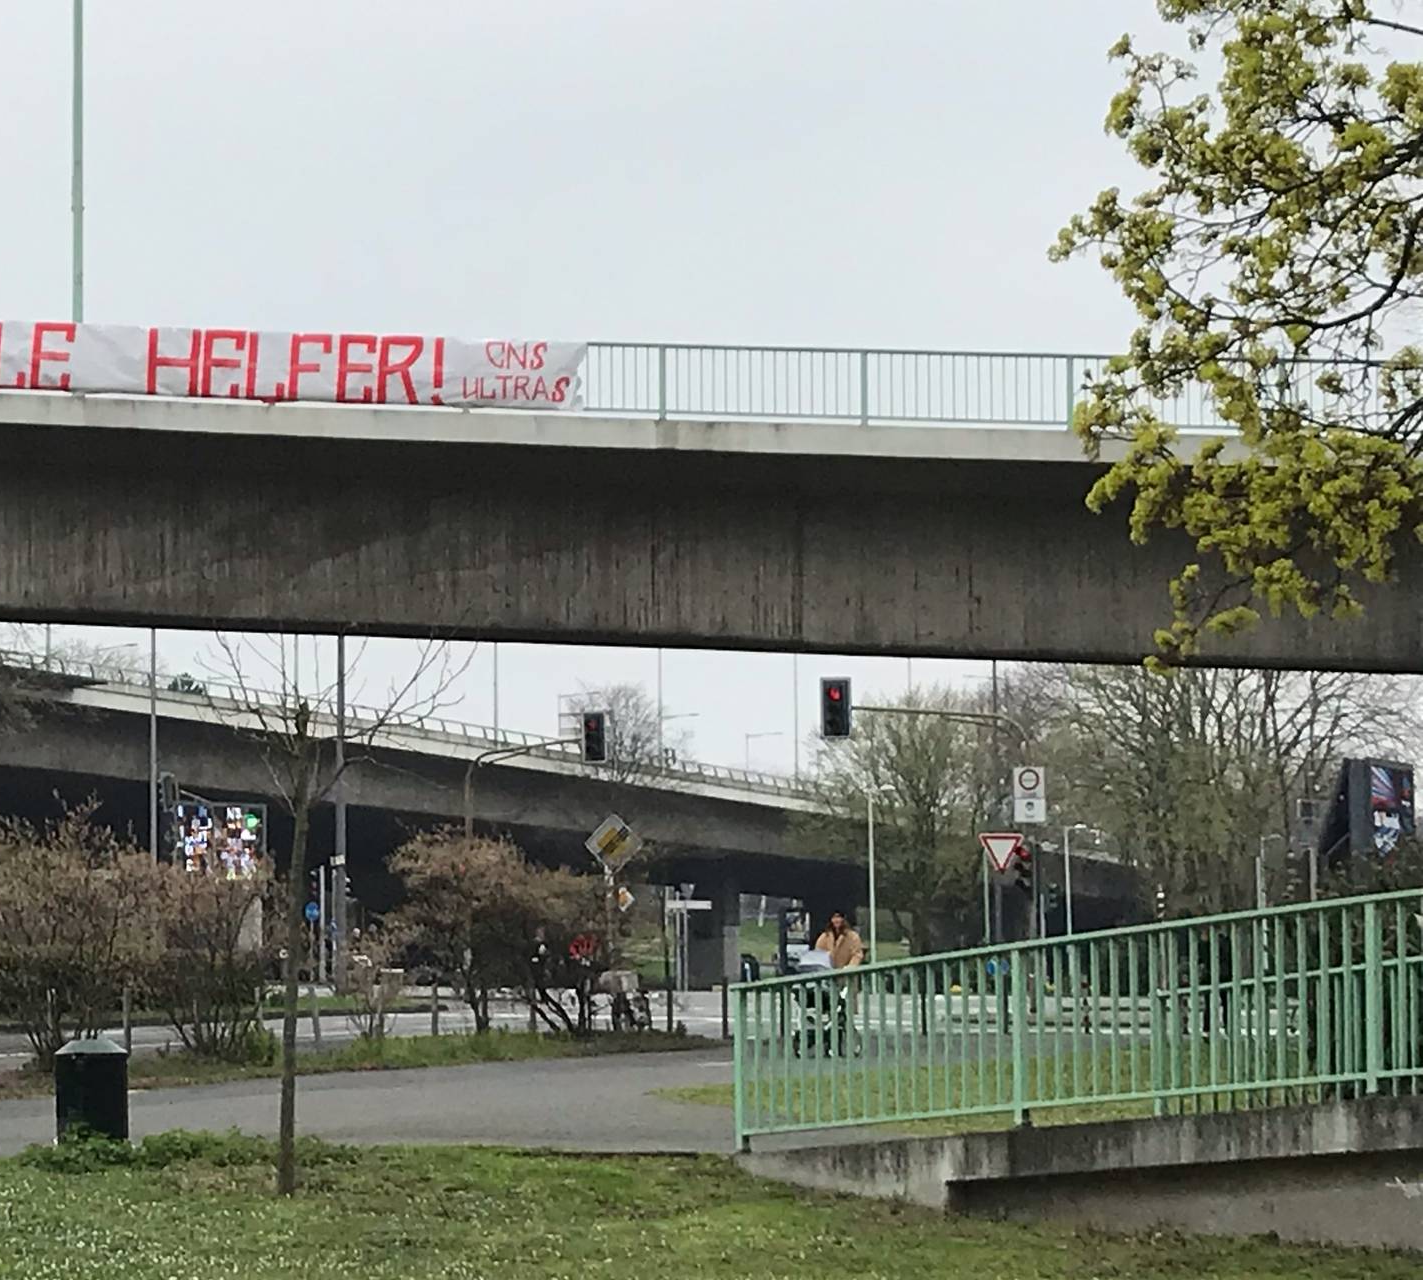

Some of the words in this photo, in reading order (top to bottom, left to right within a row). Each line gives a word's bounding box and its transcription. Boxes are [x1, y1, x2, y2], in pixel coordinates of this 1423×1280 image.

[144, 328, 446, 406] HELFER!
[485, 341, 548, 371] CNS
[462, 375, 571, 403] ULTRAS
